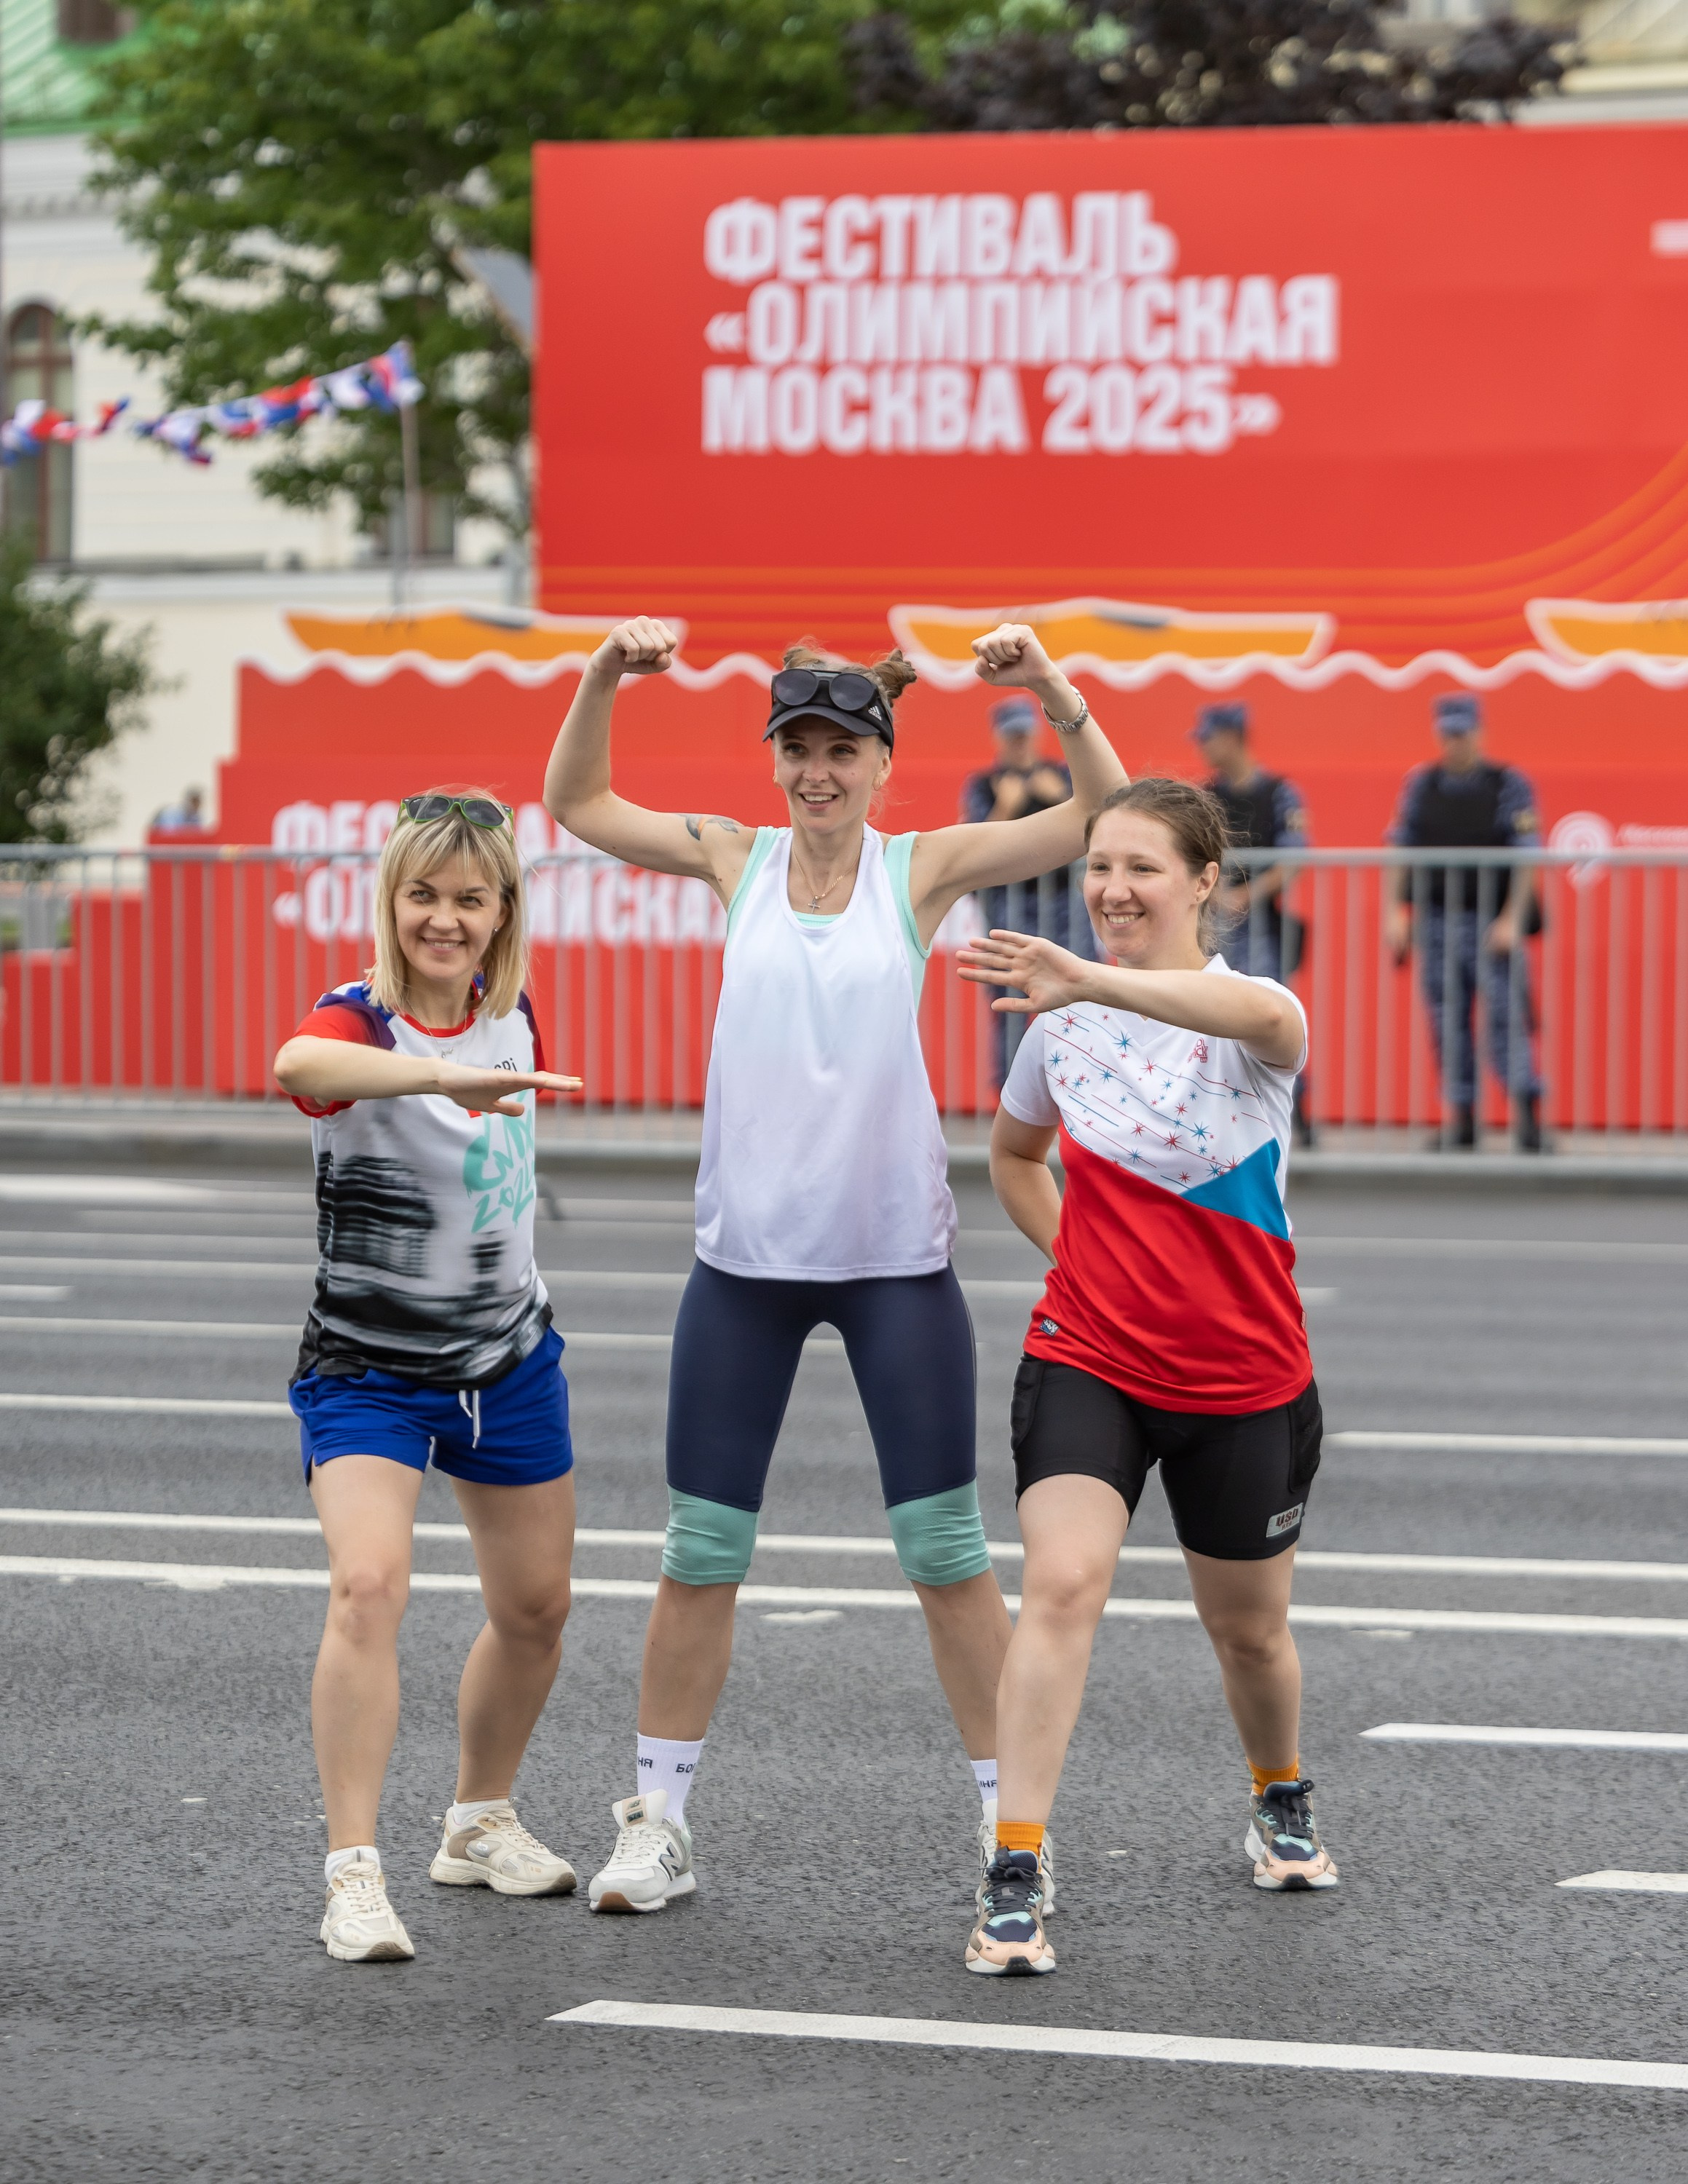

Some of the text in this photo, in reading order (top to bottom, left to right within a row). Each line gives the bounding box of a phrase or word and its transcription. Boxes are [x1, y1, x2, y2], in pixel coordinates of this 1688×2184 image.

[705, 191, 1177, 284] ФЕСТИВАЛЬ
[705, 274, 1338, 367] «ОЛИМПИЙСКАЯ
[702, 366, 1280, 455] МОСКВА 2025»
